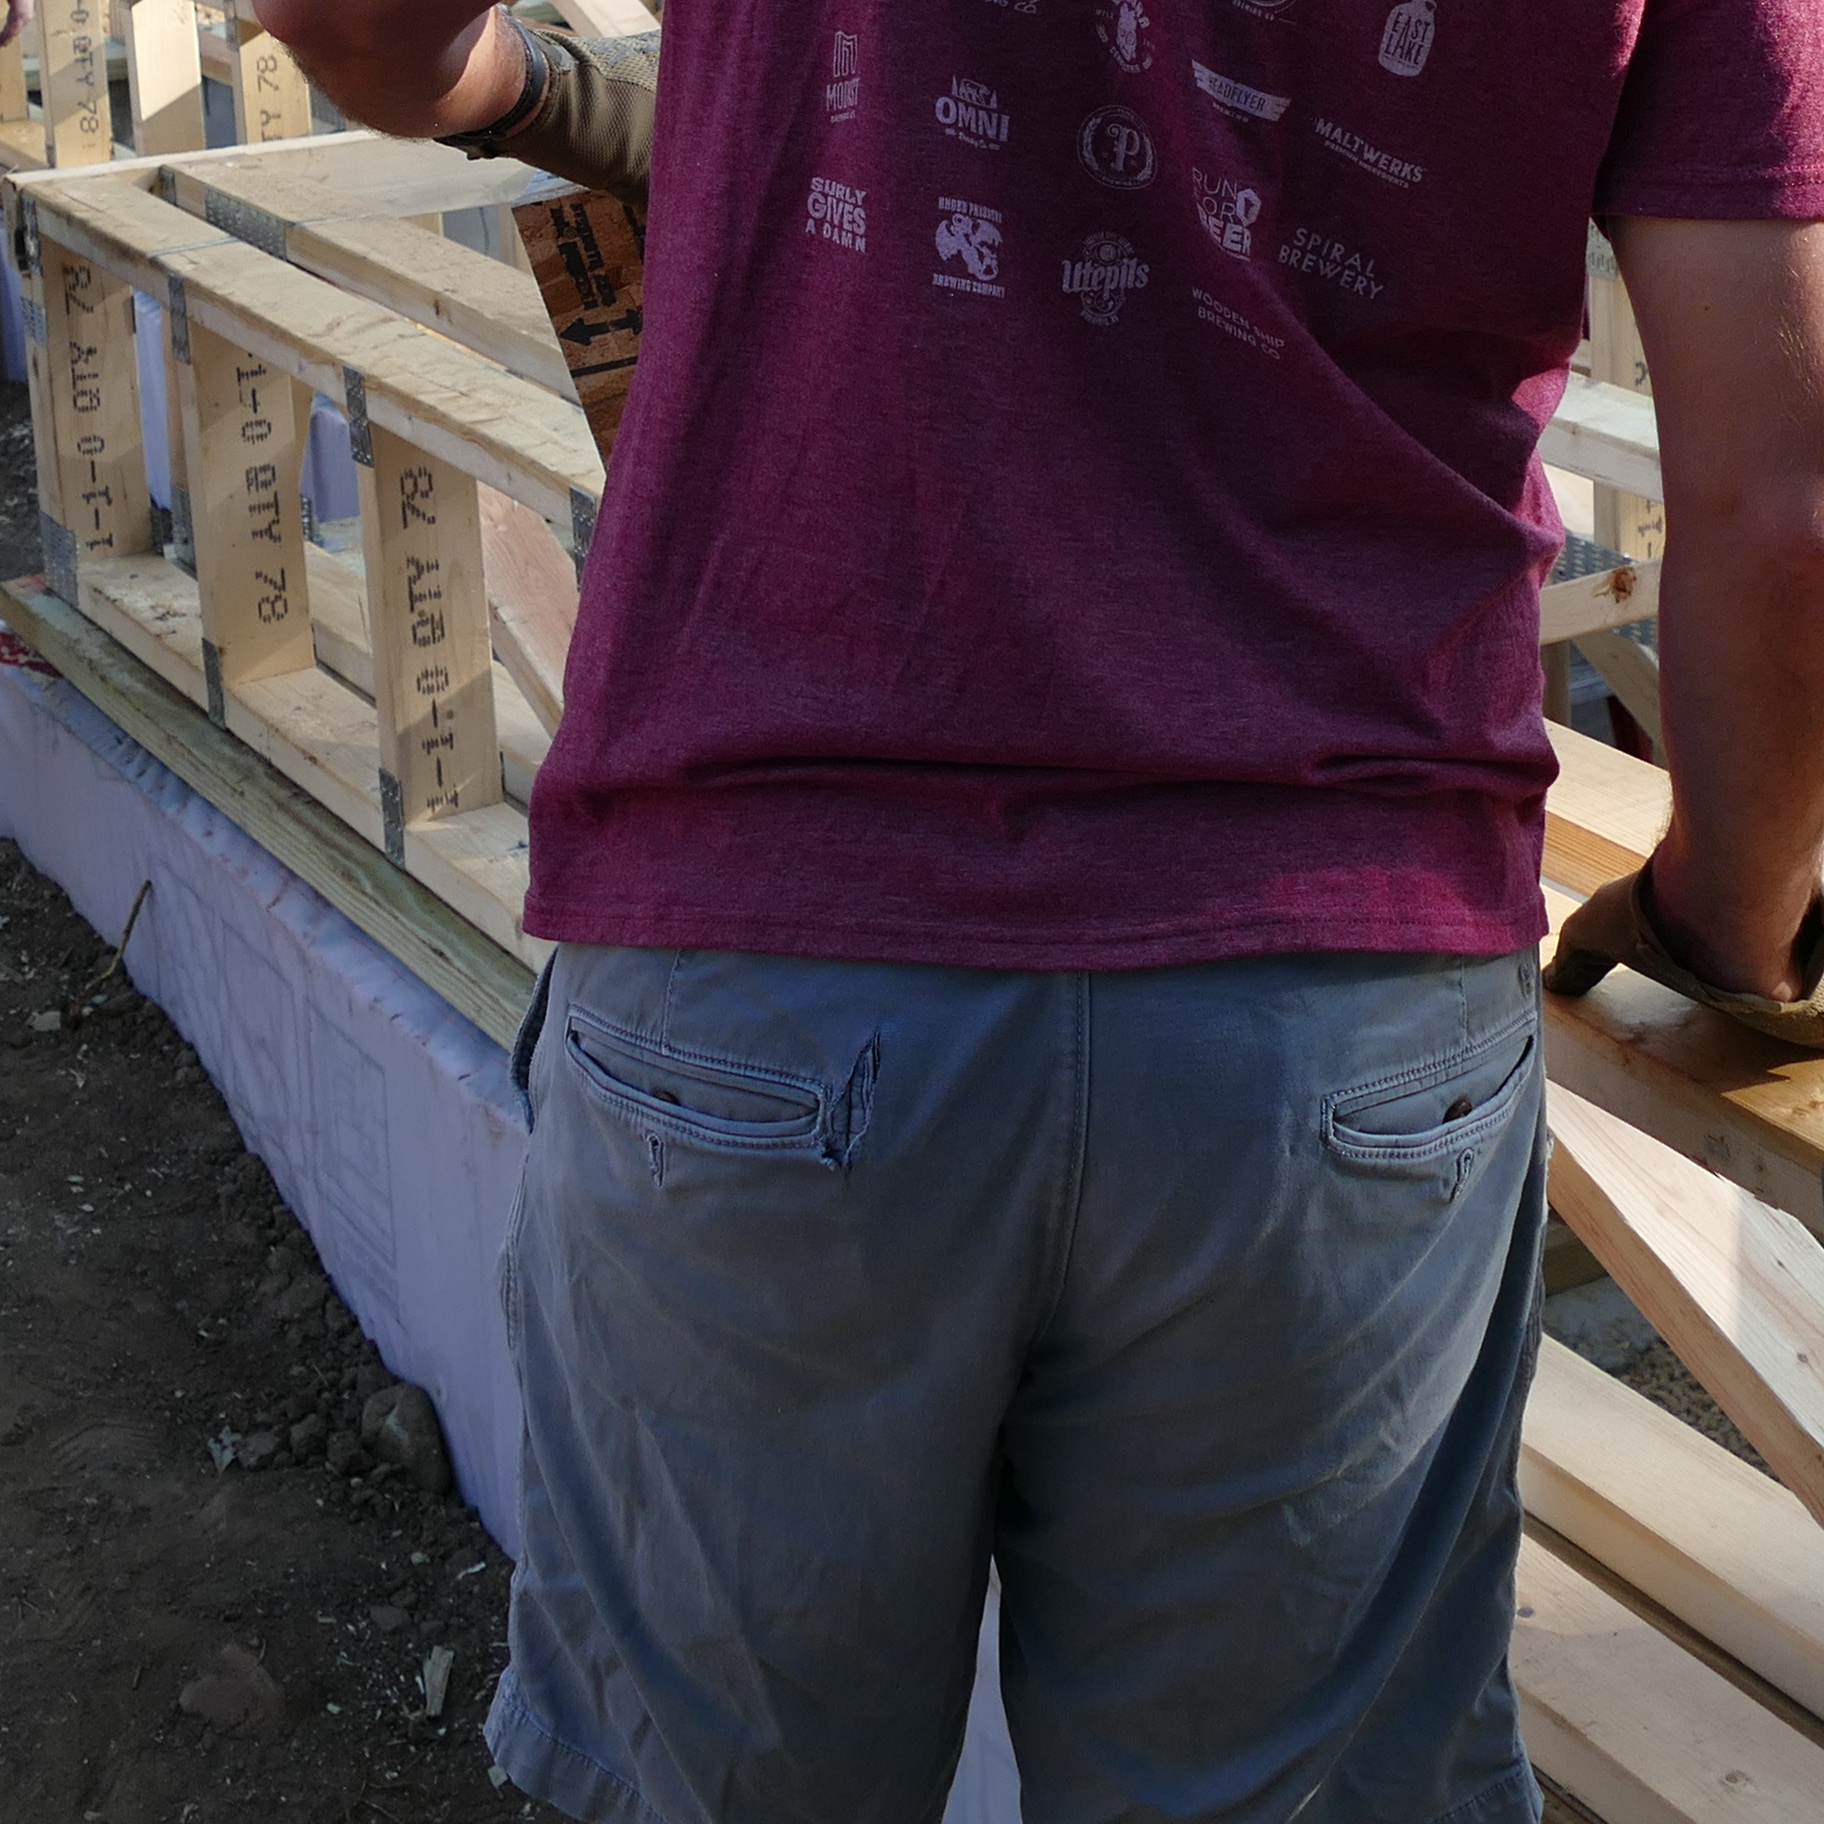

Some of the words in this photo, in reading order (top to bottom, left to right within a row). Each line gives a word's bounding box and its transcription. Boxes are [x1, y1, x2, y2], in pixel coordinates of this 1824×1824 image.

[1384, 34, 1425, 67] LAKE
[1390, 11, 1432, 44] EAST
[74, 37, 94, 87] QTY
[256, 54, 278, 94] 78
[76, 96, 99, 135] 78
[935, 96, 1010, 142] OMNI
[1314, 118, 1424, 184] MALTWERKS
[810, 176, 868, 206] SURLY
[1192, 166, 1238, 200] RUN
[805, 218, 816, 235] A
[823, 222, 866, 254] DAMN
[807, 191, 866, 236] GIVES
[1279, 244, 1384, 300] BREWERY
[1293, 228, 1376, 277] SPIRAL
[1061, 257, 1151, 300] Utepils
[1191, 286, 1250, 330] WOODEN
[1254, 325, 1285, 349] SHIP
[1198, 306, 1257, 347] BREWING
[1261, 341, 1281, 360] CO
[68, 340, 100, 414] QTY
[76, 433, 114, 550] 1-1-0
[245, 462, 282, 544] QTY
[398, 466, 437, 530] 78
[253, 567, 289, 624] 78
[406, 554, 447, 649] QTY
[415, 666, 460, 810] 1-1-0
